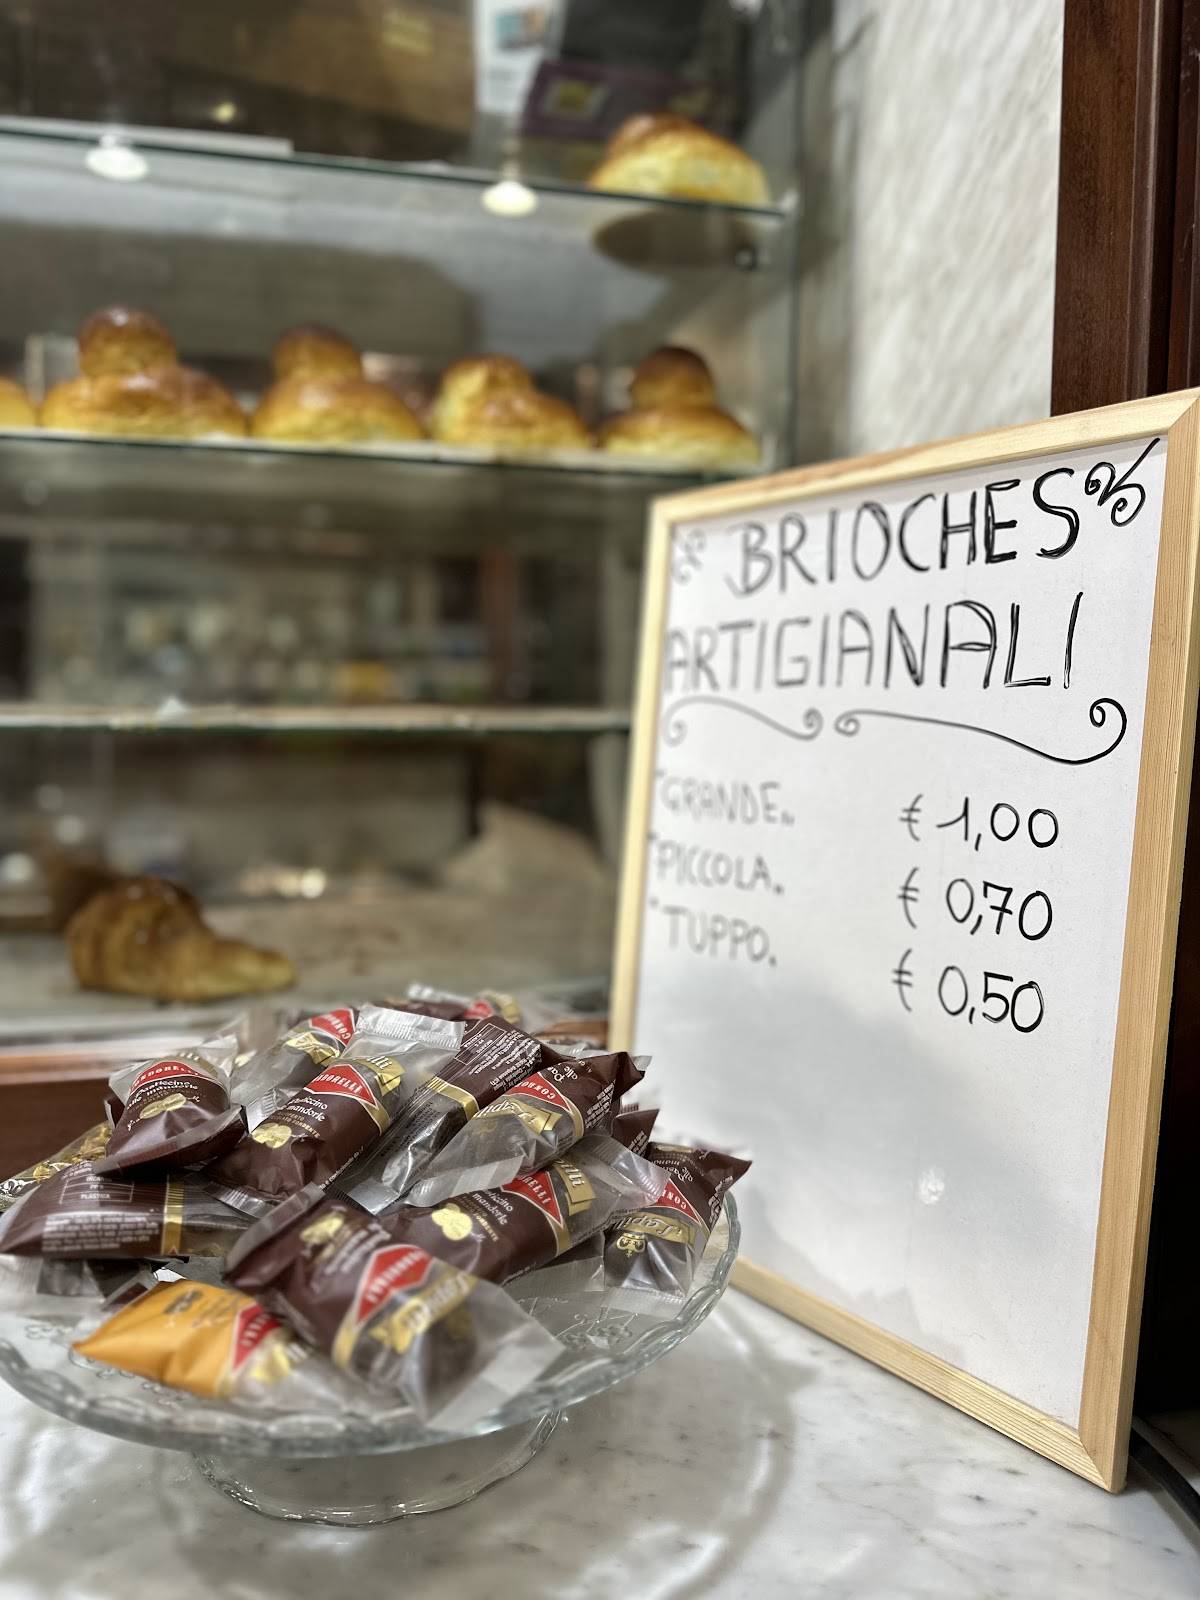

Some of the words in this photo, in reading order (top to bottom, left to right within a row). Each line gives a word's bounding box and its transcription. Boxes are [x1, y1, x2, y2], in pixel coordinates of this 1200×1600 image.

[725, 467, 1080, 597] BRIOCHES
[664, 592, 1084, 692] ARTIGIANALI
[899, 793, 924, 841] €
[936, 796, 1060, 851] 1,00
[897, 867, 920, 929] €
[946, 878, 1053, 941] 0,70
[892, 948, 914, 1012] €
[938, 966, 1045, 1033] 0,50
